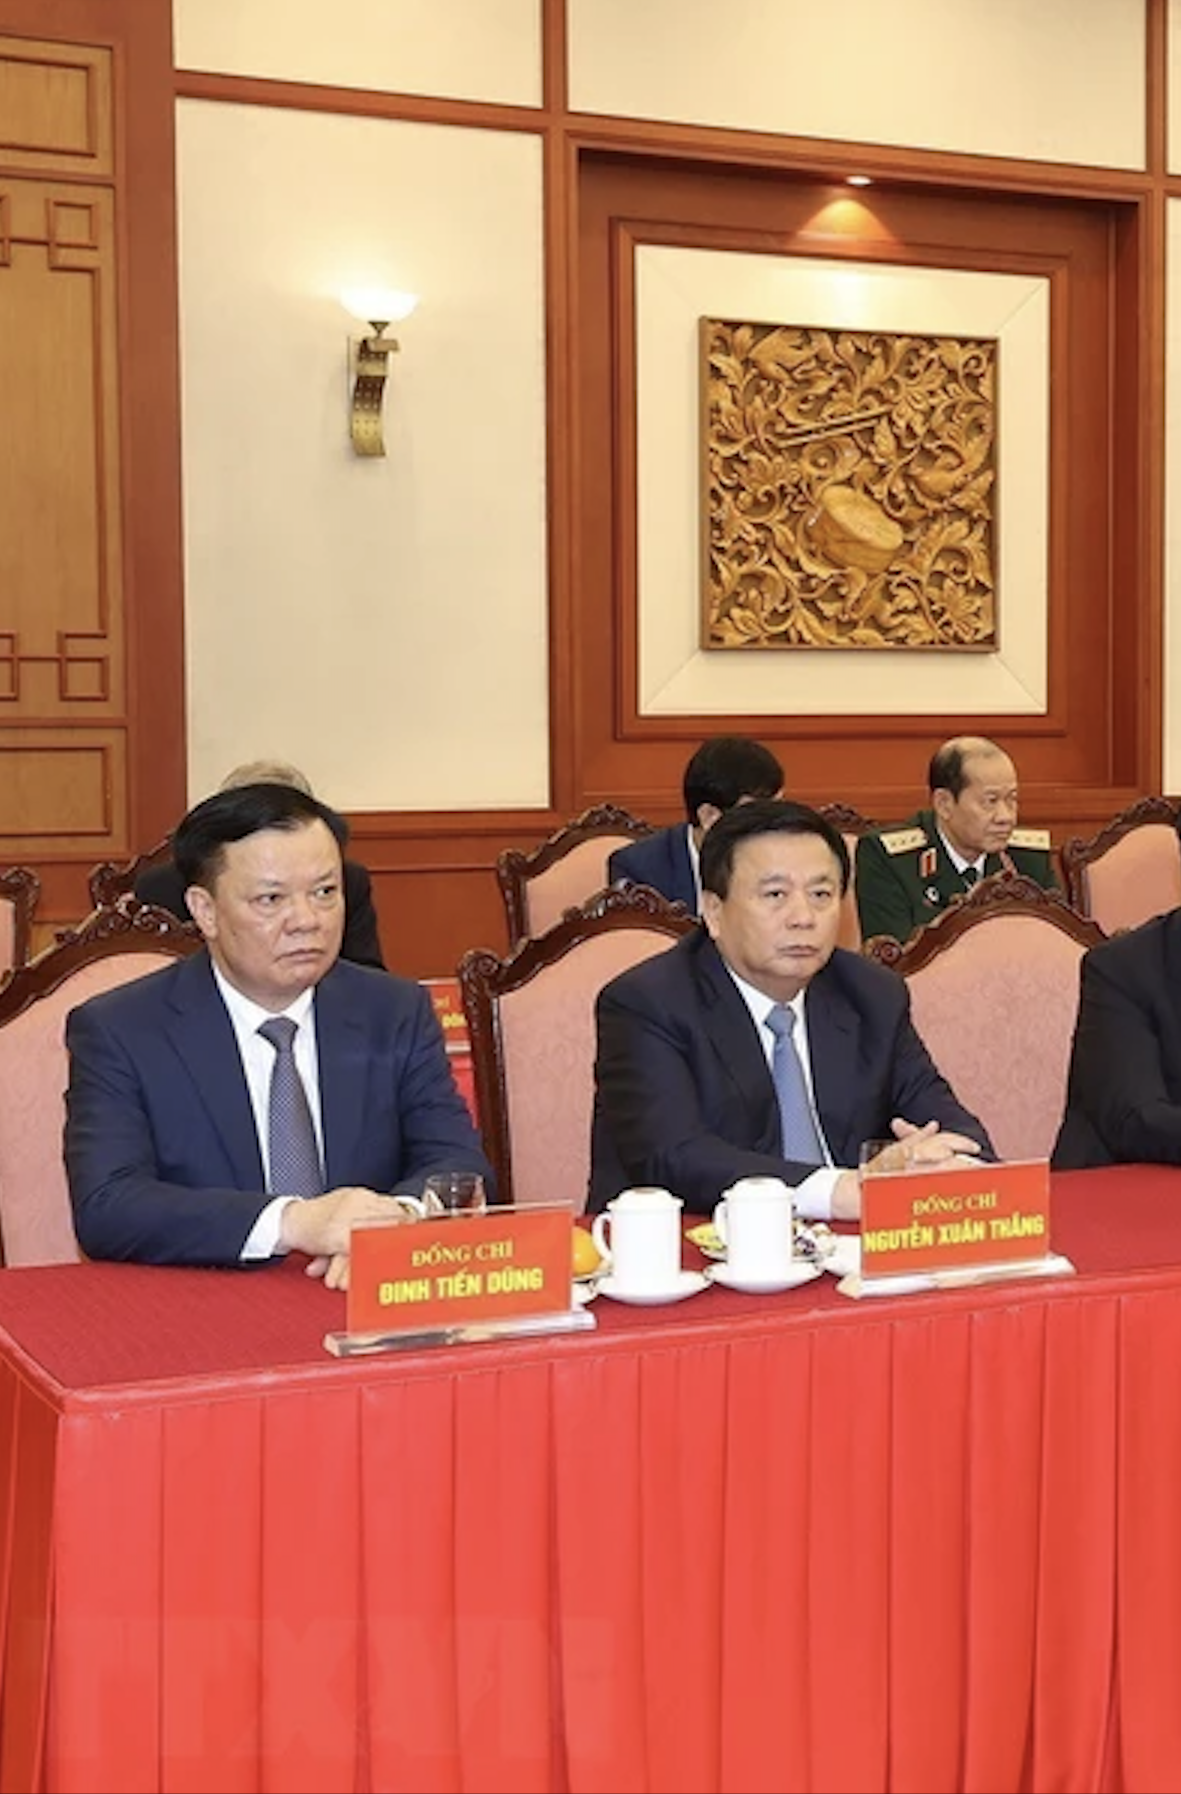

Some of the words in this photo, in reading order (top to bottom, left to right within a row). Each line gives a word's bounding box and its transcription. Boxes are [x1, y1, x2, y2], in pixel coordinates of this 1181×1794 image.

[912, 1193, 962, 1215] ĐỒNG
[965, 1191, 997, 1210] CHÍ
[864, 1220, 933, 1252] NGUYỄN
[938, 1217, 984, 1244] XUÂN
[989, 1210, 1044, 1239] THẮNG
[412, 1241, 471, 1267] ĐỒNG
[475, 1237, 514, 1261] CHÍ
[378, 1278, 430, 1306] ĐINH
[436, 1266, 481, 1298] TIẾN
[487, 1267, 543, 1294] DŨNG
